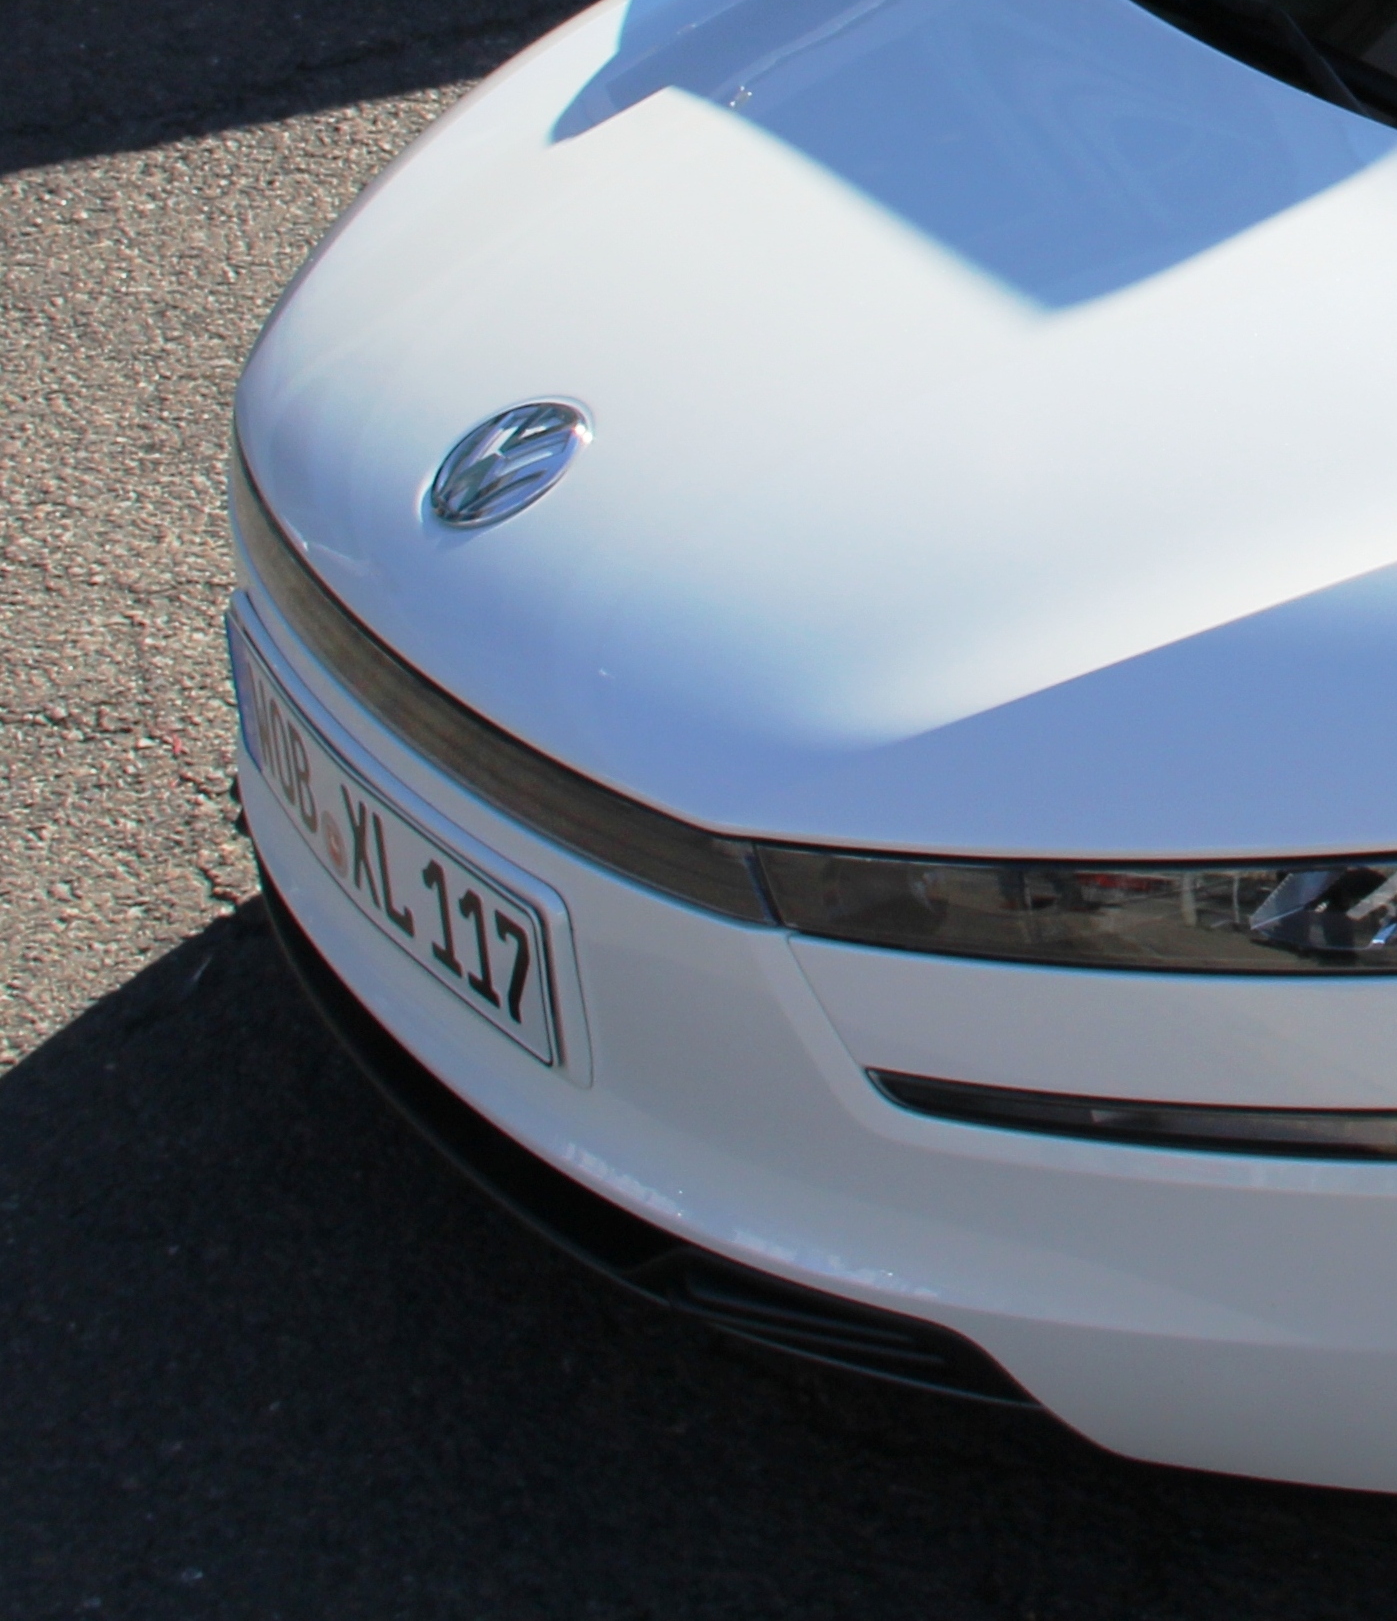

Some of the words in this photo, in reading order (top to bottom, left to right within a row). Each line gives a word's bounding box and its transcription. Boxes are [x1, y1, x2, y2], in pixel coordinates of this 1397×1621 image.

[247, 661, 320, 835] WOB
[339, 782, 416, 939] XL
[421, 857, 532, 1025] 117
